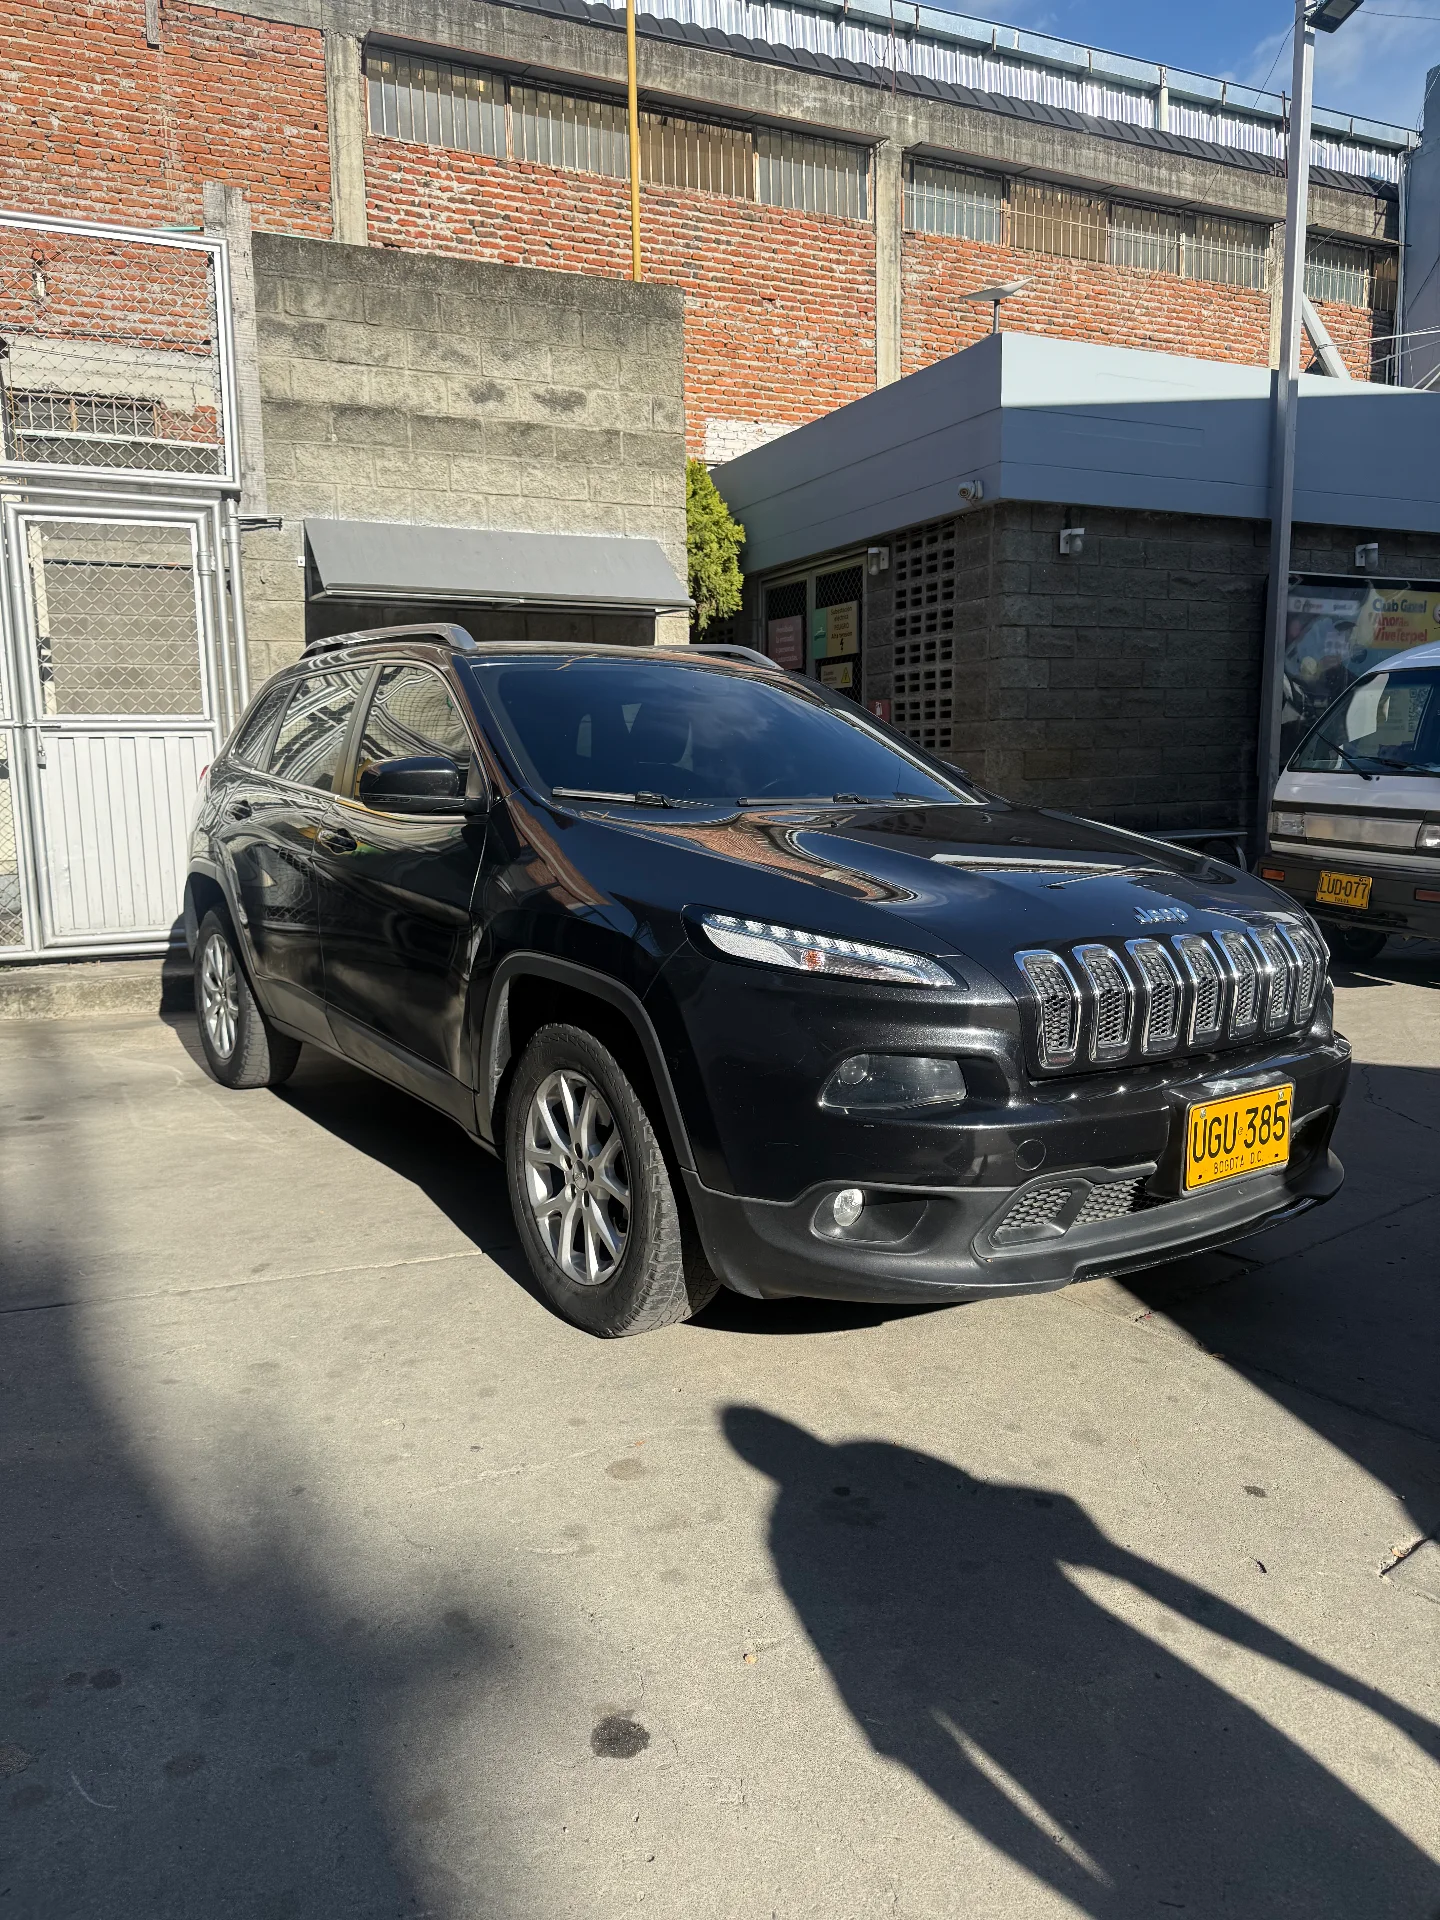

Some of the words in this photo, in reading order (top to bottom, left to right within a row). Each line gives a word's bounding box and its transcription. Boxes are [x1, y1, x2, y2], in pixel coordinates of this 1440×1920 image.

[834, 622, 849, 630] PELIGRO
[1133, 906, 1189, 925] Jeep
[1192, 1111, 1239, 1163] UGU
[1243, 1100, 1288, 1149] 385
[1213, 1155, 1245, 1175] BOGOTA
